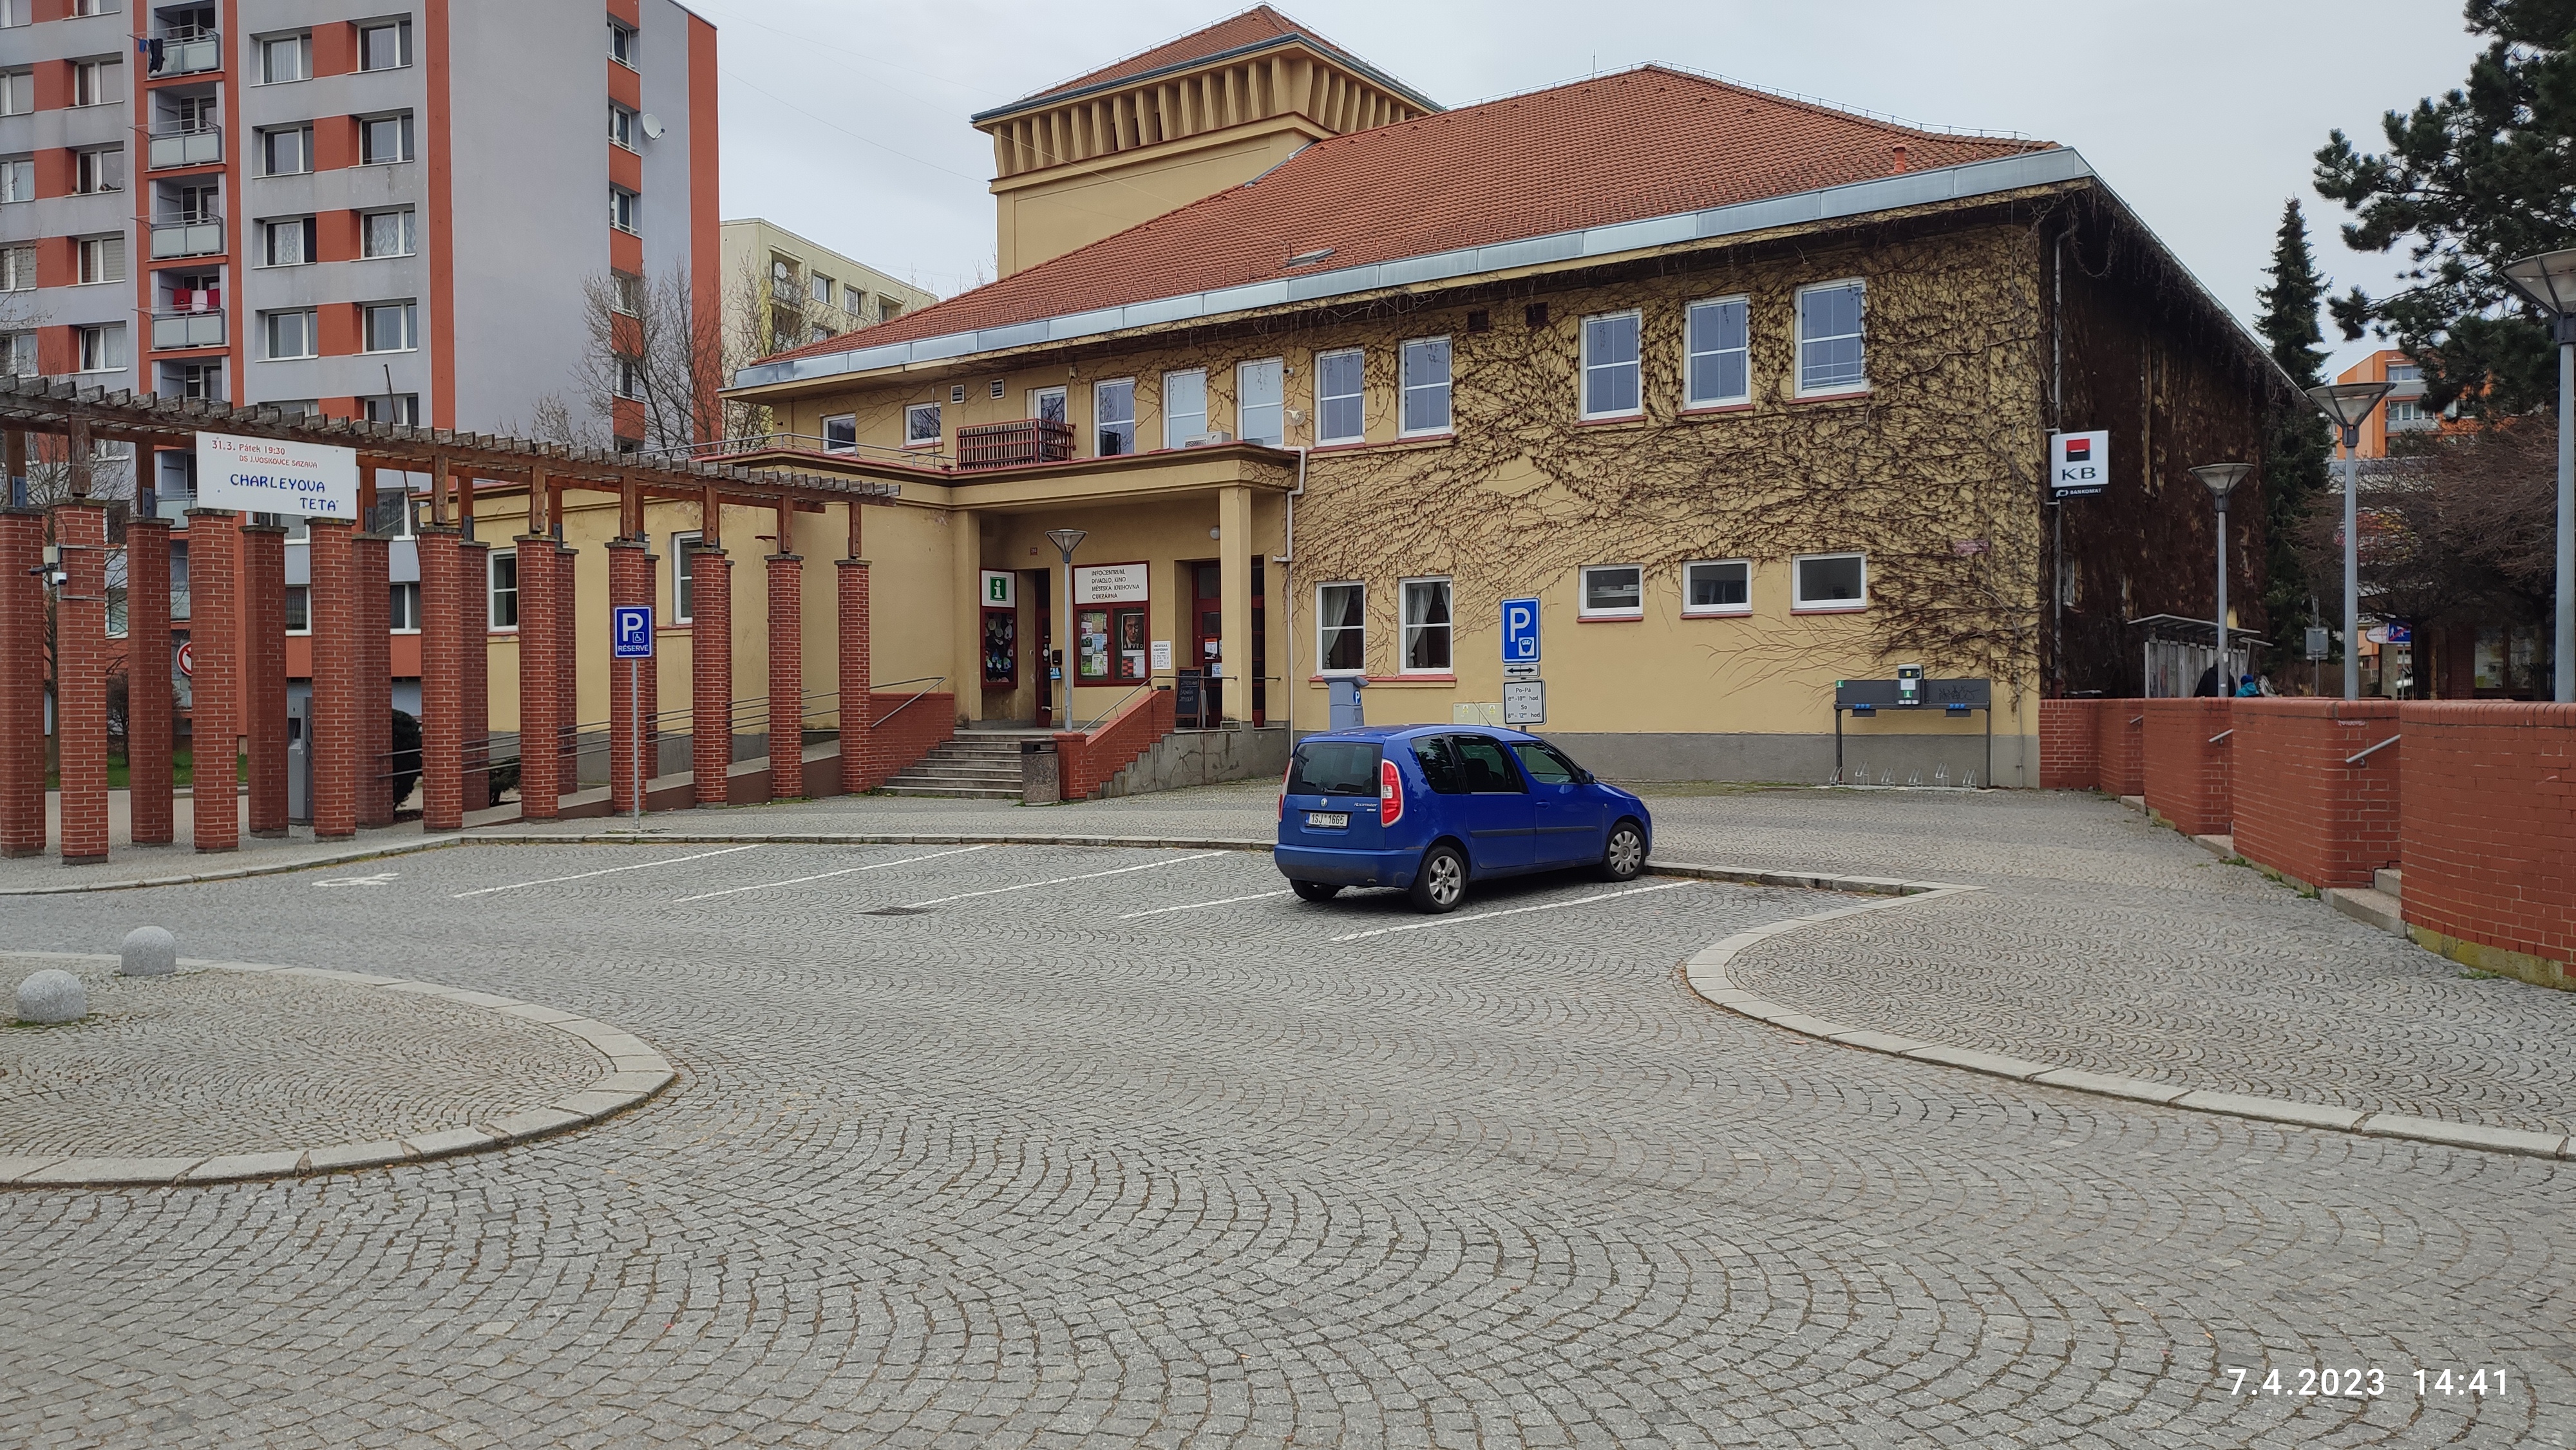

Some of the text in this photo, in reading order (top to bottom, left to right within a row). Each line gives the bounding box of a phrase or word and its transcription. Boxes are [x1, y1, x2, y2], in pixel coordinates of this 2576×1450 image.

[212, 440, 285, 455] 31.3. Pátek 19:30
[2061, 467, 2096, 481] KB
[230, 473, 325, 493] CHARLEYOVA
[299, 497, 336, 511] TETA
[622, 613, 644, 642] P
[1510, 607, 1531, 643] P
[1355, 691, 1360, 704] P
[1311, 814, 1323, 824] 1SJ
